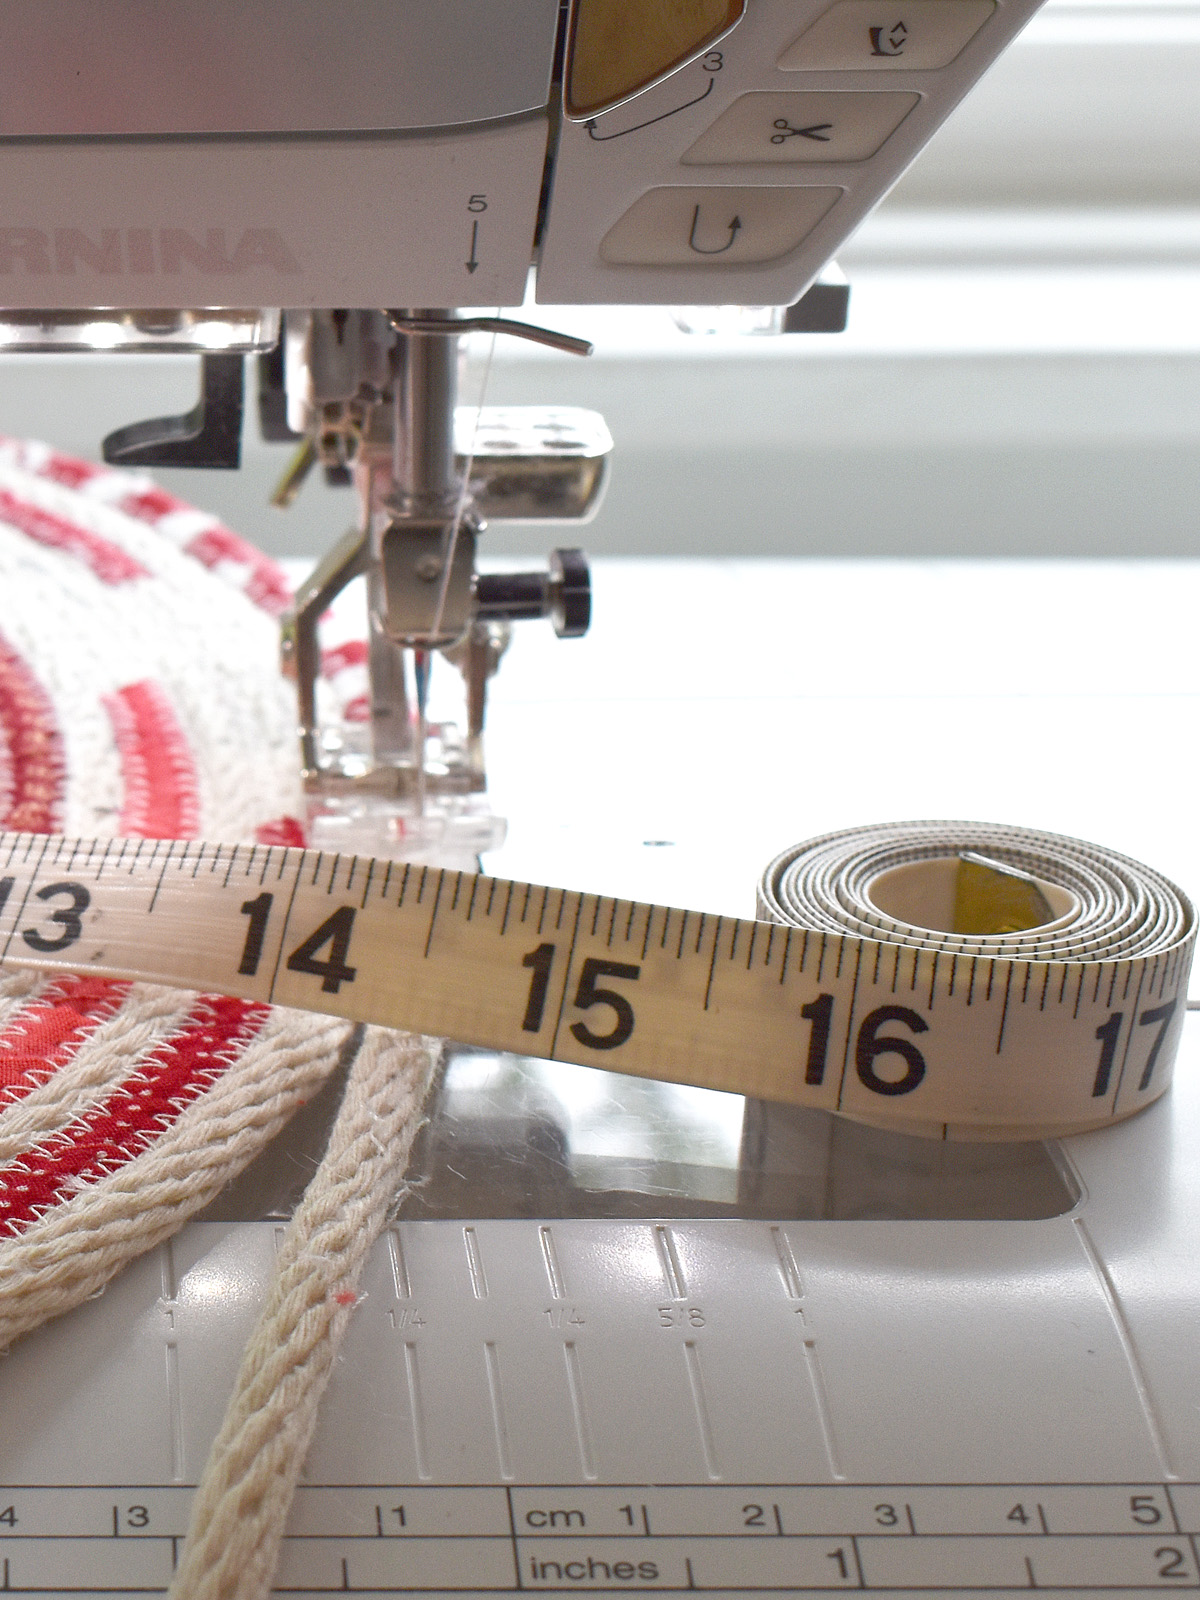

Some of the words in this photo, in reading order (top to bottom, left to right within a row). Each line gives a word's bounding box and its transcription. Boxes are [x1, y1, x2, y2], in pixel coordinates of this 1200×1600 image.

[702, 51, 724, 72] 3
[466, 194, 488, 214] 5
[236, 891, 358, 994] 14
[520, 942, 641, 1050] 15
[799, 992, 931, 1097] 16
[1092, 1000, 1179, 1098] 17
[127, 1505, 150, 1527] 3
[391, 1505, 407, 1527] 1
[525, 1508, 586, 1527] cm
[618, 1505, 634, 1526] 1
[741, 1504, 765, 1526] 2
[874, 1503, 898, 1525] 3
[1007, 1503, 1029, 1525] 4
[1129, 1496, 1161, 1525] 5
[530, 1556, 659, 1580] inches
[826, 1547, 849, 1579] 1
[1154, 1546, 1188, 1578] 2
